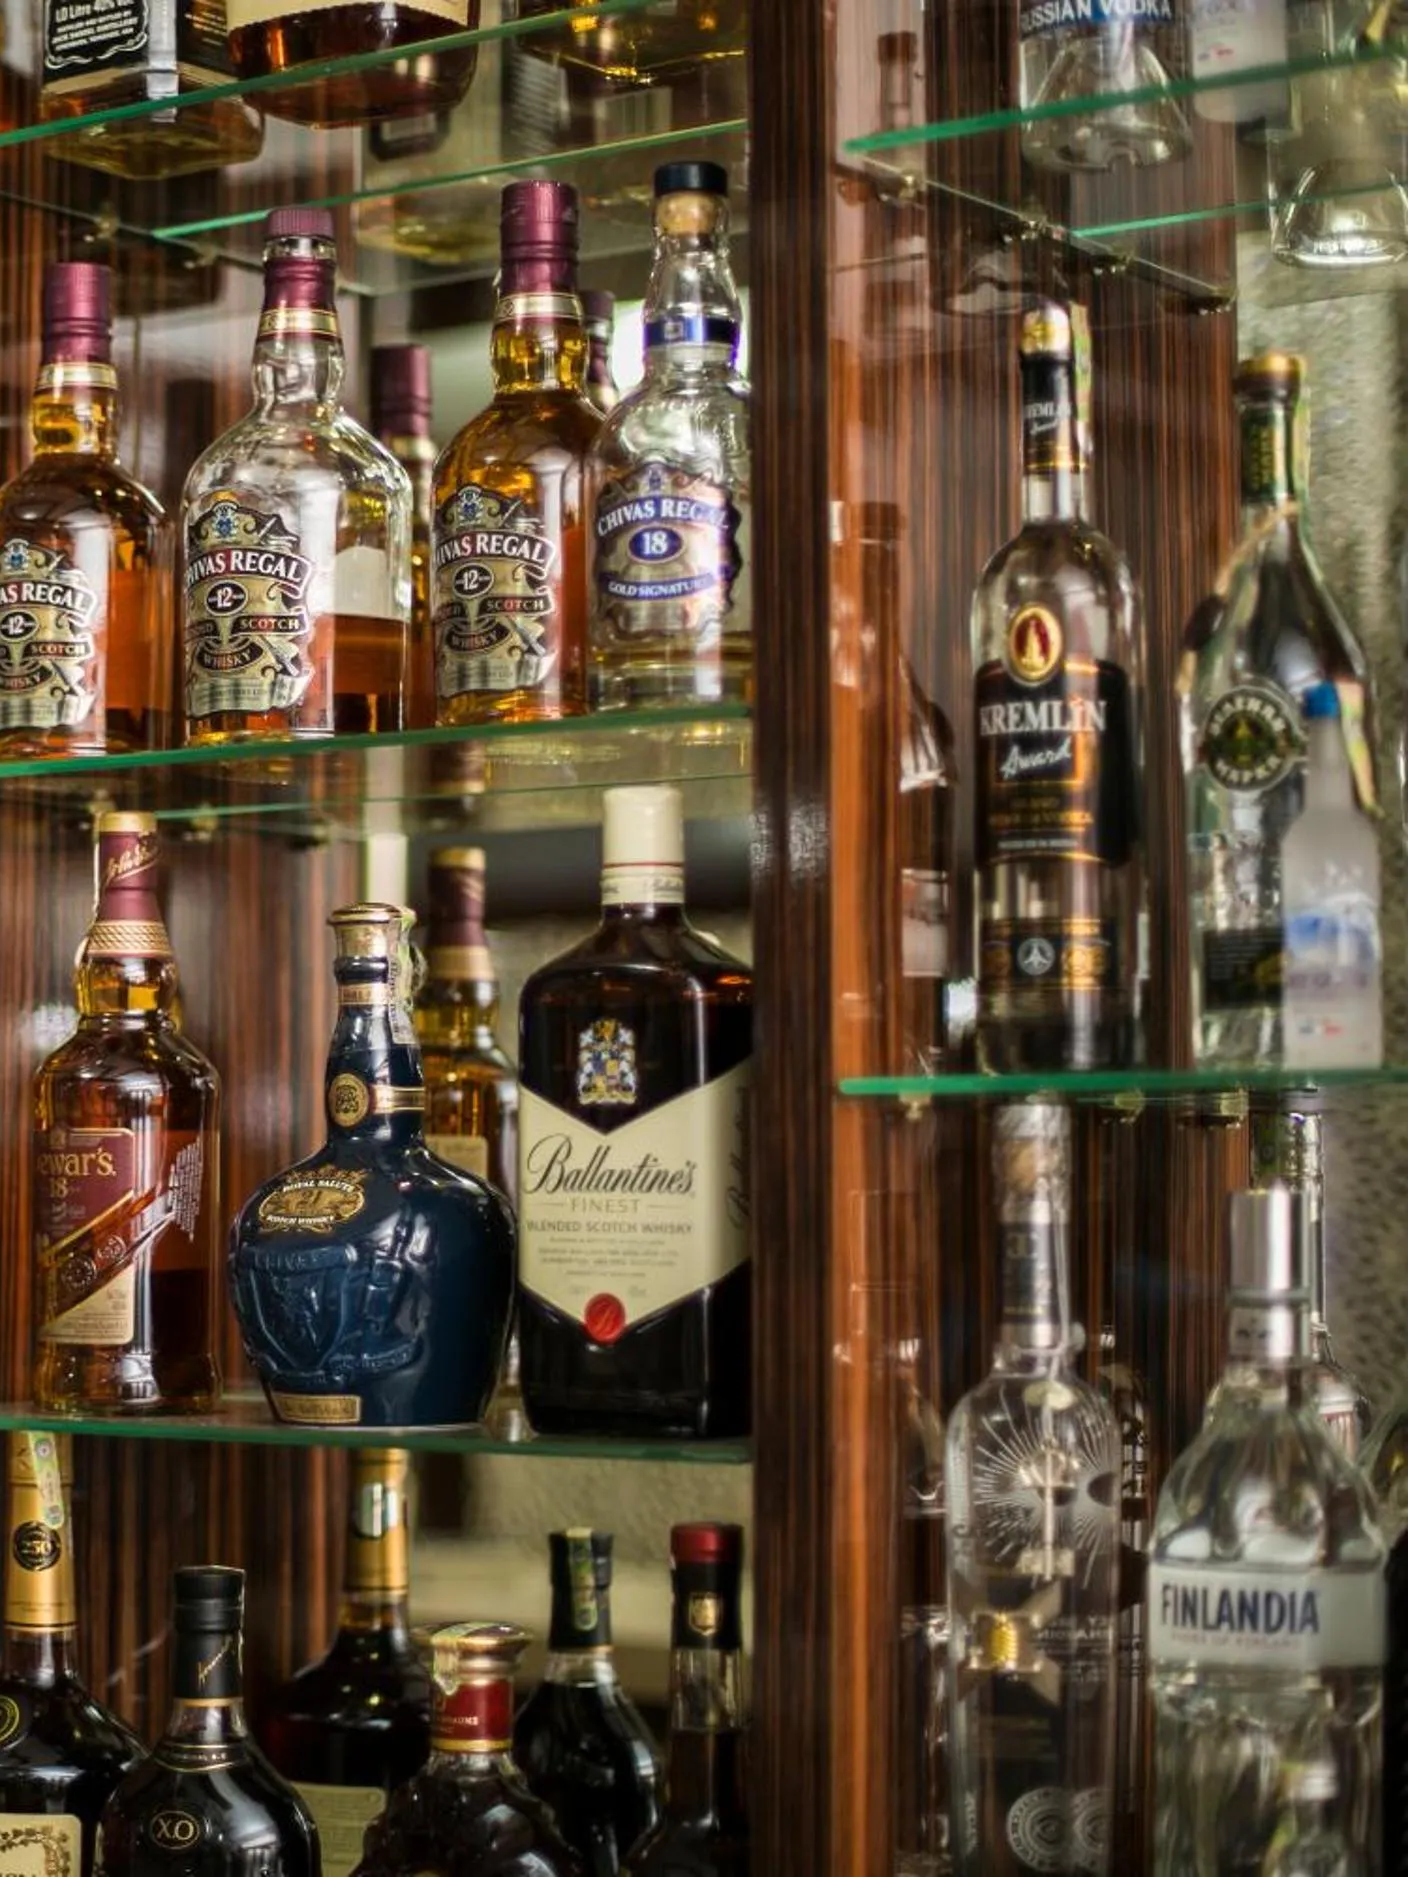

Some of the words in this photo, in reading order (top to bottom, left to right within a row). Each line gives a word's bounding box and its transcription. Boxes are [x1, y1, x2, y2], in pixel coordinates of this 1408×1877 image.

[598, 498, 656, 537] CHIVAS
[476, 533, 545, 562] REGAL
[643, 531, 668, 556] 18
[230, 550, 303, 583] REGAL
[463, 569, 479, 591] 12
[21, 581, 86, 612] REGAL
[216, 586, 233, 609] 12
[486, 599, 545, 612] SCOTCH
[7, 614, 25, 636] 12
[240, 618, 301, 631] SCOTCH
[30, 643, 86, 656] SCOTCH
[202, 649, 252, 668] WHISKY
[980, 699, 1107, 736] KREMLIN
[523, 1133, 698, 1195] Ballantine's
[570, 1198, 641, 1214] FINEST
[527, 1220, 581, 1233] BLENDED
[586, 1221, 638, 1234] SCOTCH
[641, 1222, 693, 1235] WHISKY
[1161, 1583, 1321, 1635] FINLANDIA
